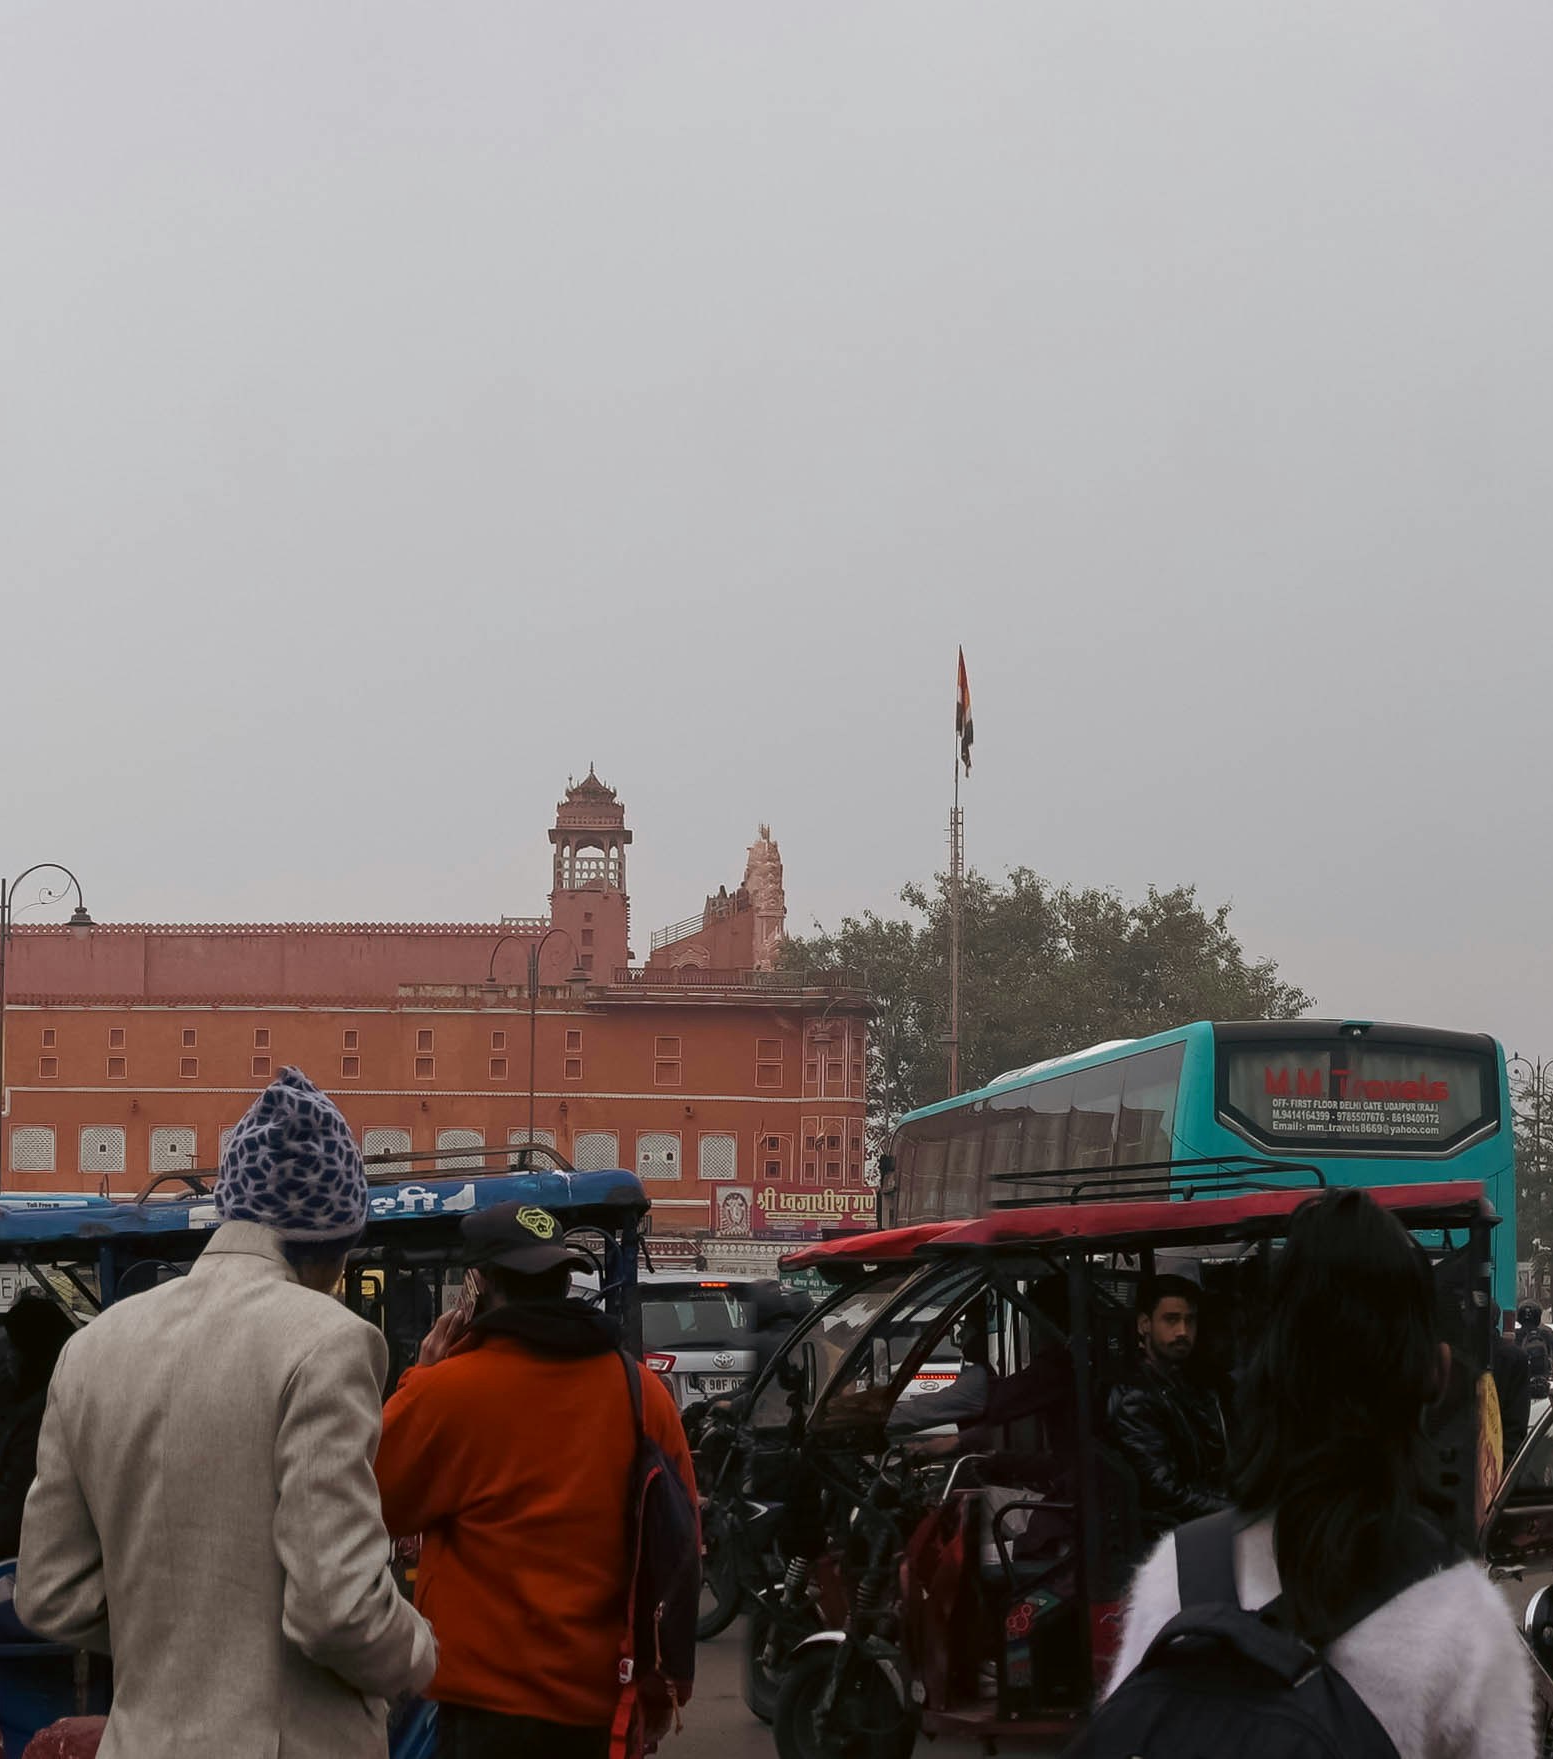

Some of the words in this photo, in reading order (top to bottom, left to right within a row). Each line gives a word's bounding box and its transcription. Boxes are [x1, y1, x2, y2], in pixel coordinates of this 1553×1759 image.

[1331, 1069, 1450, 1102] Travels
[1291, 1099, 1311, 1109] FIRST
[1313, 1100, 1338, 1110] FLOOR
[1339, 1101, 1361, 1111] DELHI
[1363, 1102, 1382, 1112] GATE
[1384, 1102, 1416, 1112] UDAIPUR
[757, 1187, 778, 1211] श्री
